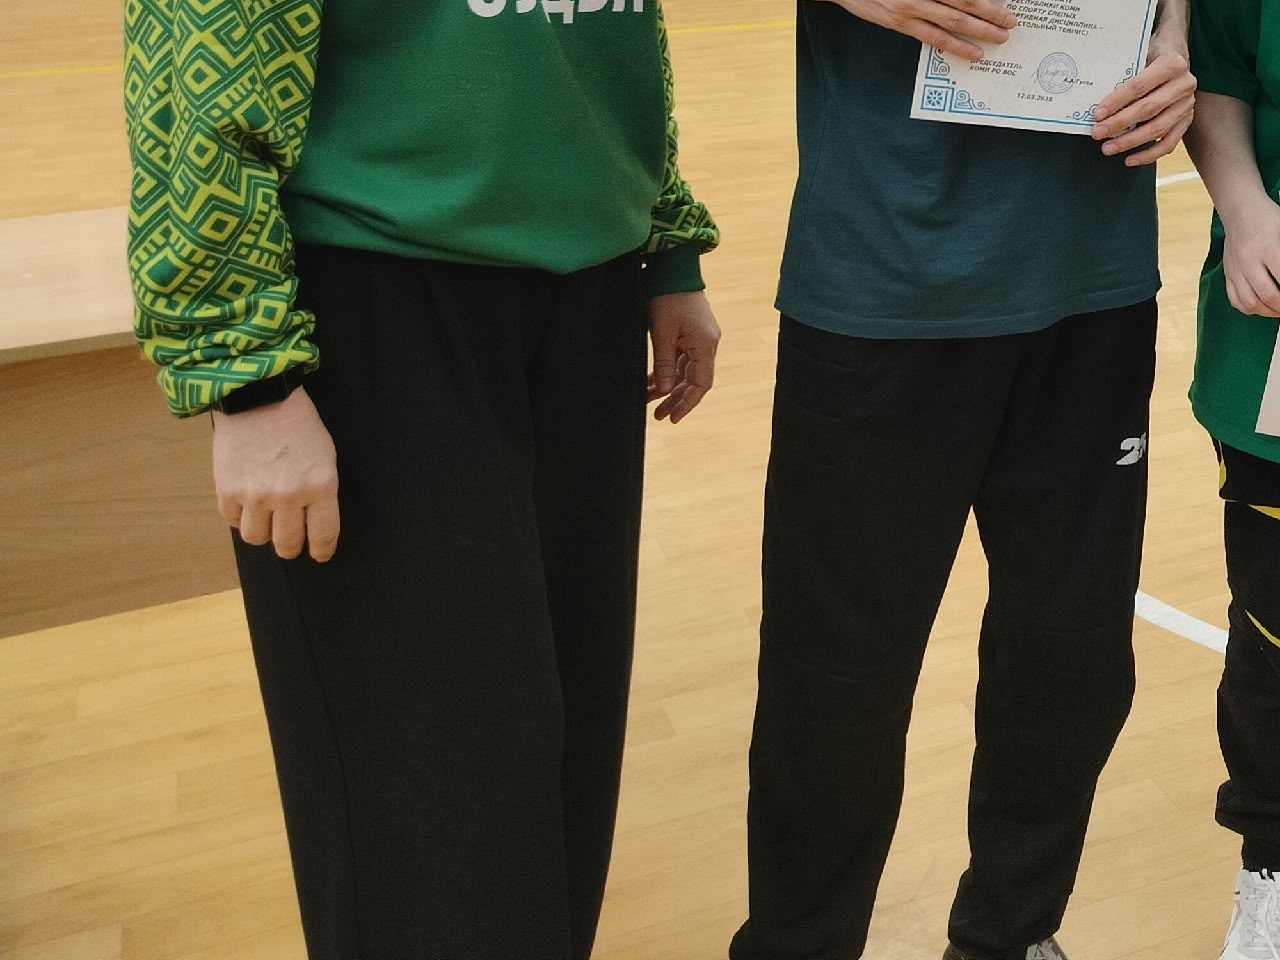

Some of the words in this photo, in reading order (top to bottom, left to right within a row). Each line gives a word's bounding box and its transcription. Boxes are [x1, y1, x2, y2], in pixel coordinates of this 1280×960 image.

[1006, 3, 1018, 11] ПО
[1018, 6, 1047, 15] СПОРТУ
[1047, 9, 1077, 19] СЛЕПЫХ
[1060, 4, 1081, 13] КОМИ
[1014, 12, 1049, 22] РТИВНАЯ
[1048, 17, 1097, 30] ДИСЦИПЛИНА
[1058, 26, 1089, 37] ТЕННИС)
[970, 59, 1023, 69] ПРЕДСЕДАТЕЛЬ
[969, 66, 990, 74] КОМИ
[1002, 69, 1017, 77] ВОС
